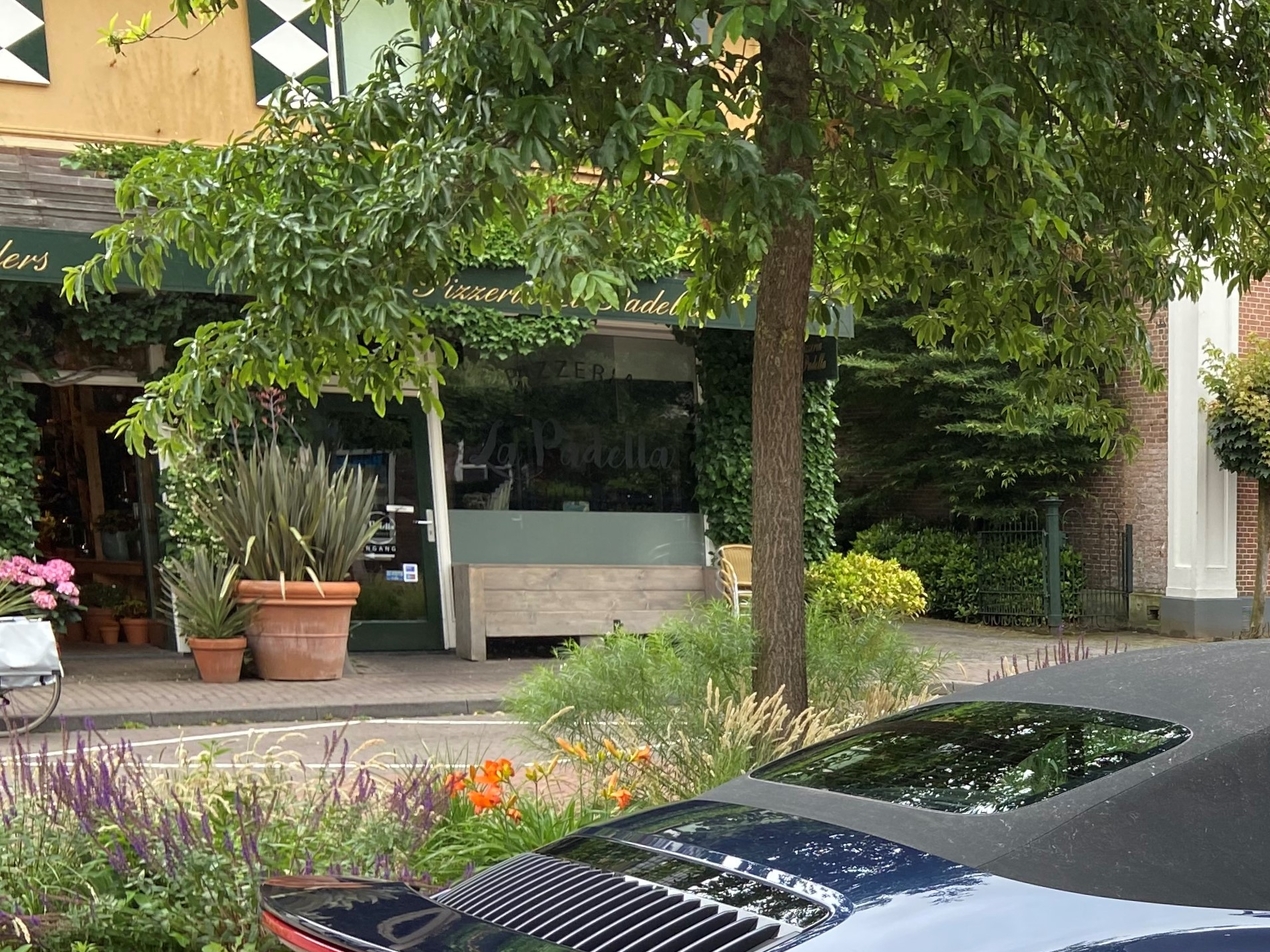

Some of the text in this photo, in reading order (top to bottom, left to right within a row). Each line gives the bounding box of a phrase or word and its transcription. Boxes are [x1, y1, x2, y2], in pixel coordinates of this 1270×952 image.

[412, 276, 536, 305] izzeri
[598, 288, 702, 318] adel
[530, 417, 677, 474] Padella
